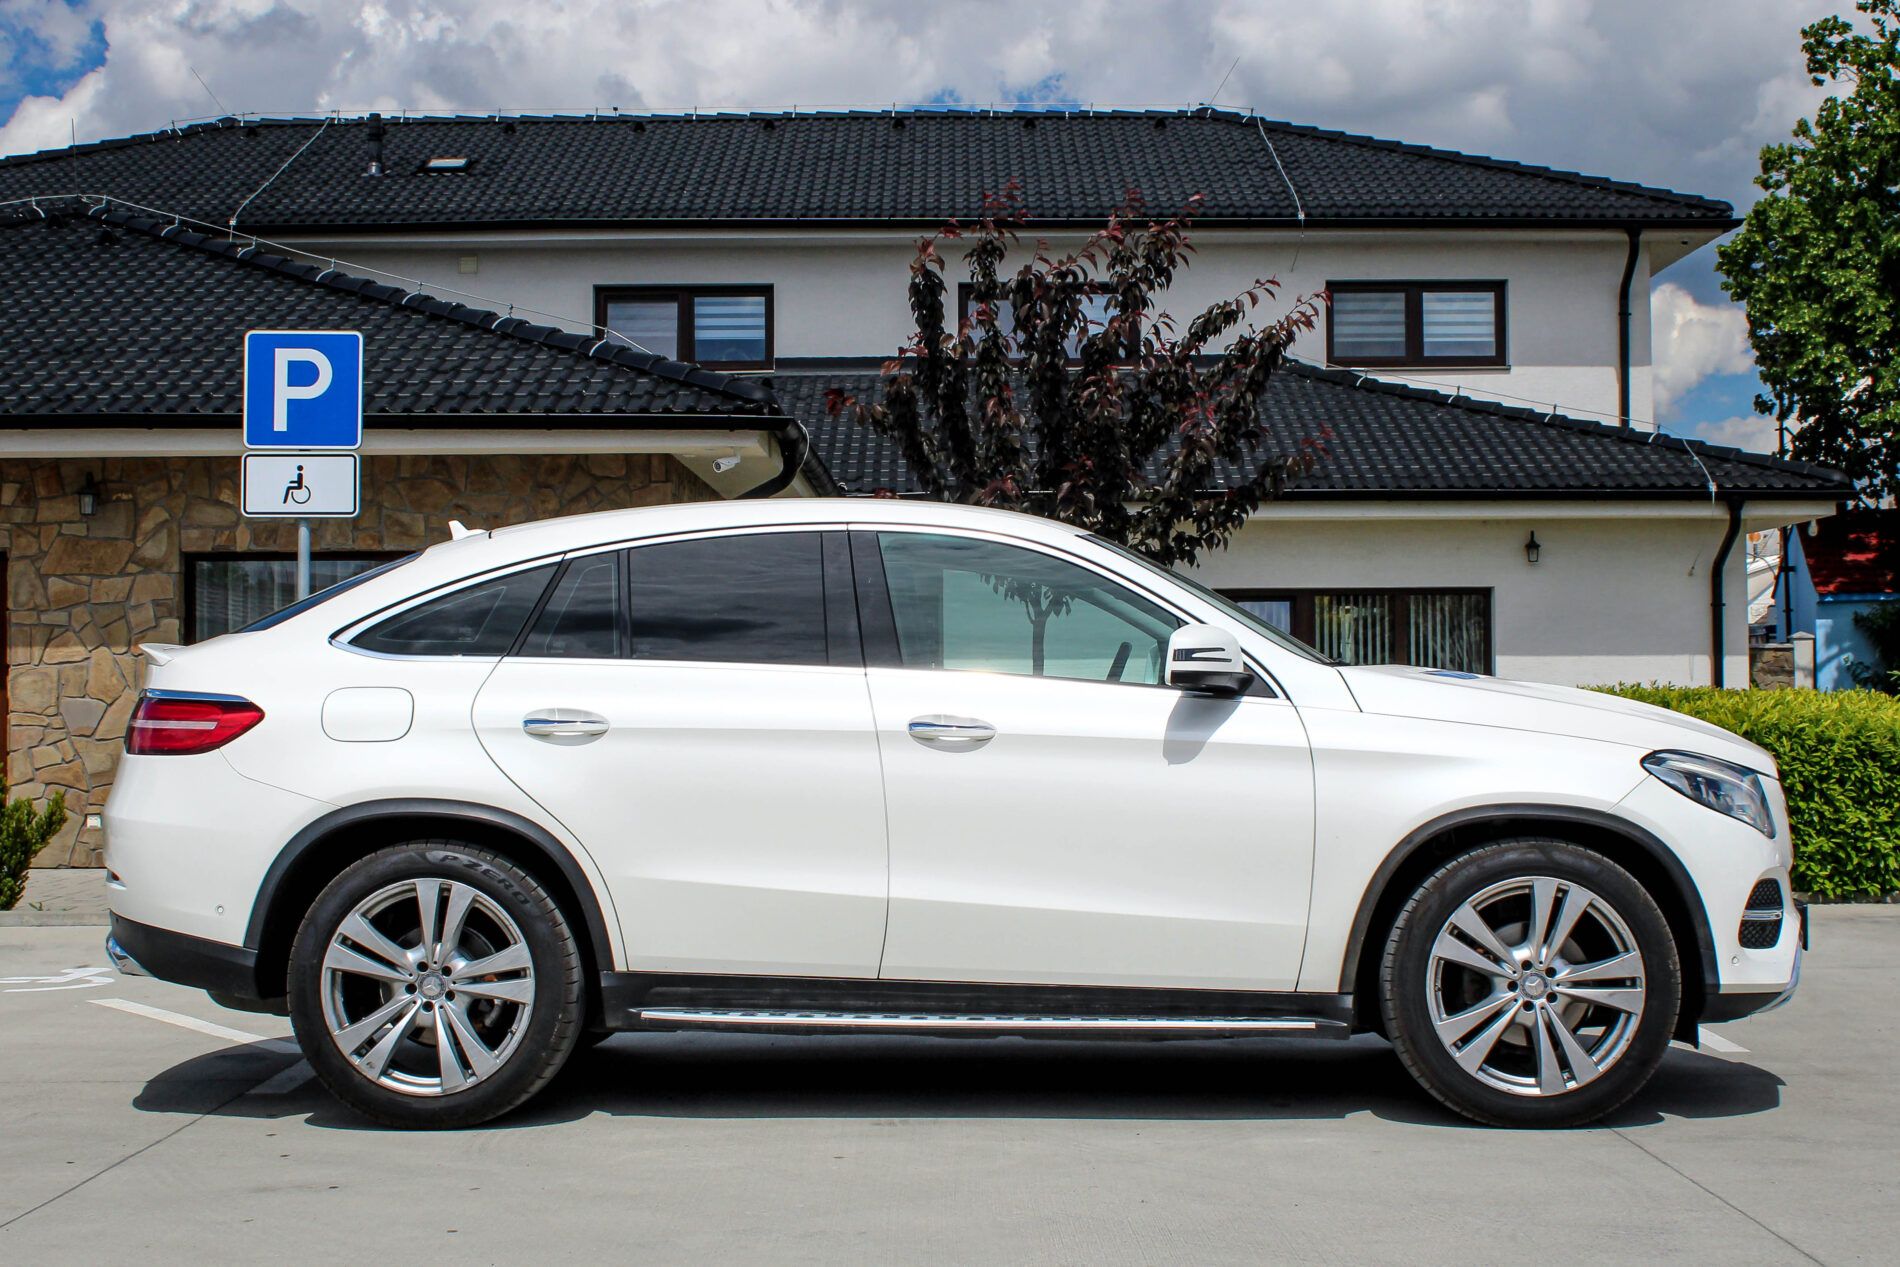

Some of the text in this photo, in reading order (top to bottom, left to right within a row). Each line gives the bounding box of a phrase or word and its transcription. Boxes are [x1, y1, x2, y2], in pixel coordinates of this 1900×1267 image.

[273, 347, 333, 432] P
[440, 853, 531, 905] P ZERO
